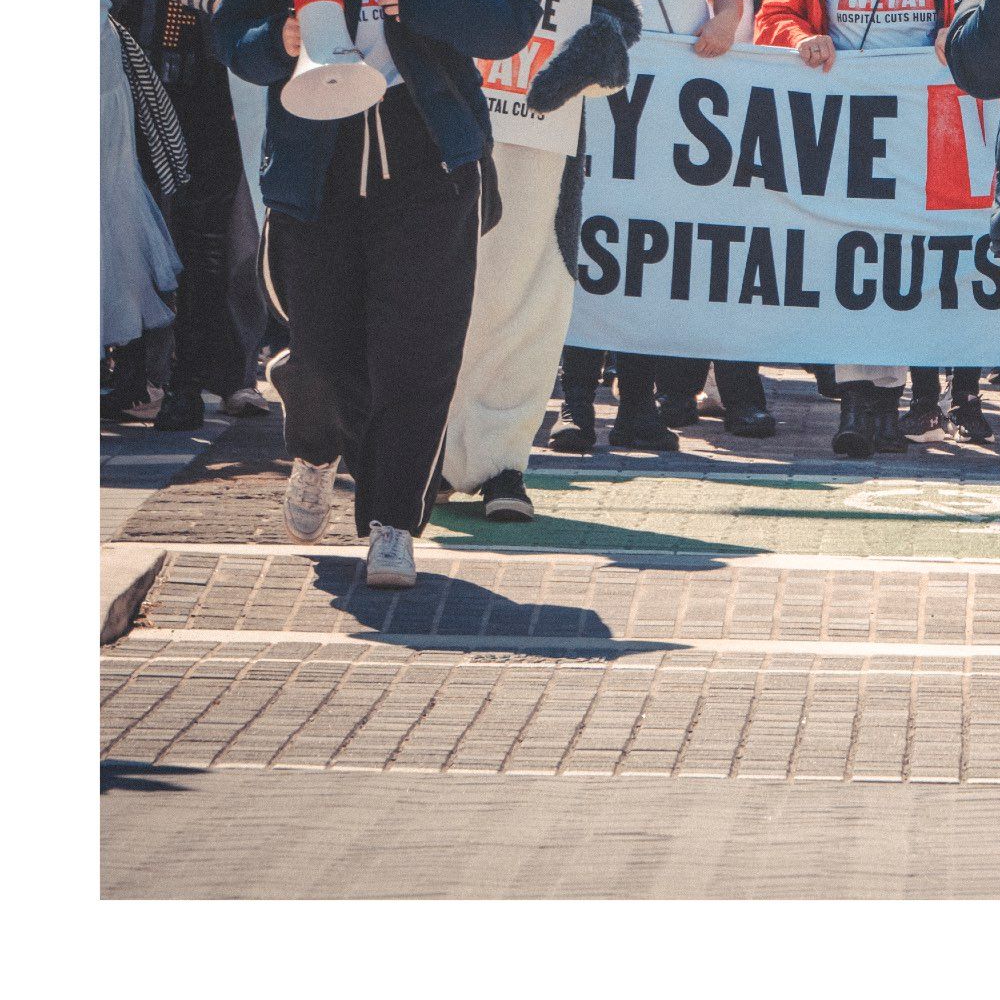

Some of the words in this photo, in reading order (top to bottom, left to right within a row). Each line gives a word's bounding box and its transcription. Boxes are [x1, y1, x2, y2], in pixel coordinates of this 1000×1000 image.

[836, 12, 881, 24] HOSPITAL
[884, 12, 910, 23] CUTS
[913, 12, 937, 23] HURT
[486, 41, 542, 90] AY
[487, 97, 509, 115] TAL
[673, 77, 898, 200] SAVE
[577, 215, 821, 308] SPITAL
